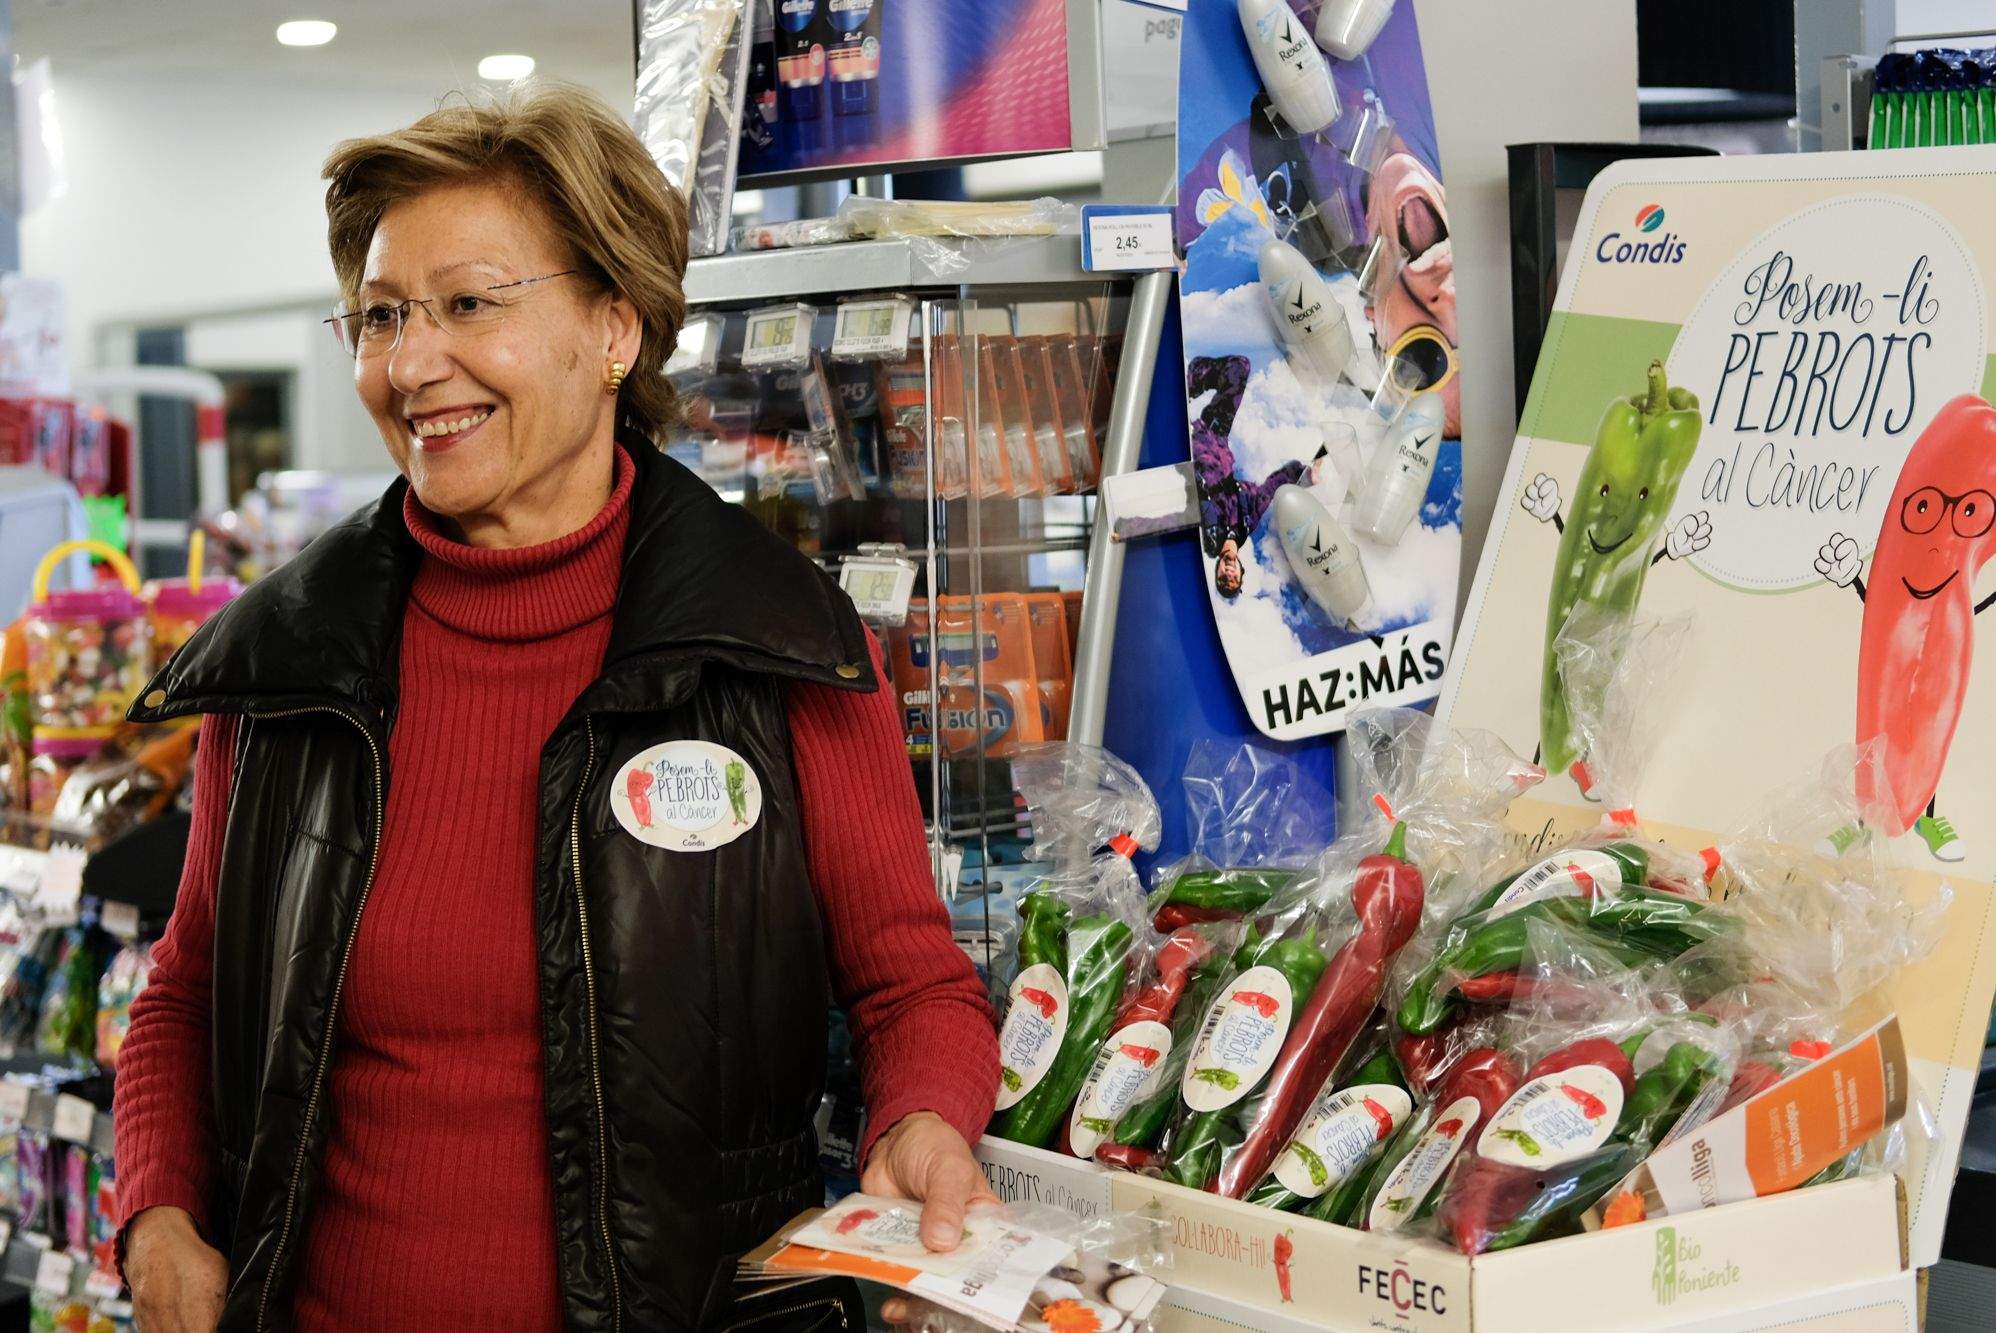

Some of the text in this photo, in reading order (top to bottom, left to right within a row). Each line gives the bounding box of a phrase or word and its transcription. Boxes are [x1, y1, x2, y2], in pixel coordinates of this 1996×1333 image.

[1279, 37, 1308, 62] Rexona
[1596, 233, 1687, 264] Condis
[1288, 301, 1321, 325] Rexona
[1709, 330, 1931, 437] PEBROTS
[1398, 444, 1430, 467] Rexona
[1701, 441, 1880, 515] al Càncer
[1307, 543, 1339, 568] Rexona
[657, 776, 720, 802] PEBROTS
[666, 807, 677, 820] al
[682, 839, 705, 847] Condis
[1224, 1016, 1262, 1064] PEBROTS
[1325, 1125, 1375, 1168] PEBROTS
[1358, 1265, 1447, 1316] FECEC
